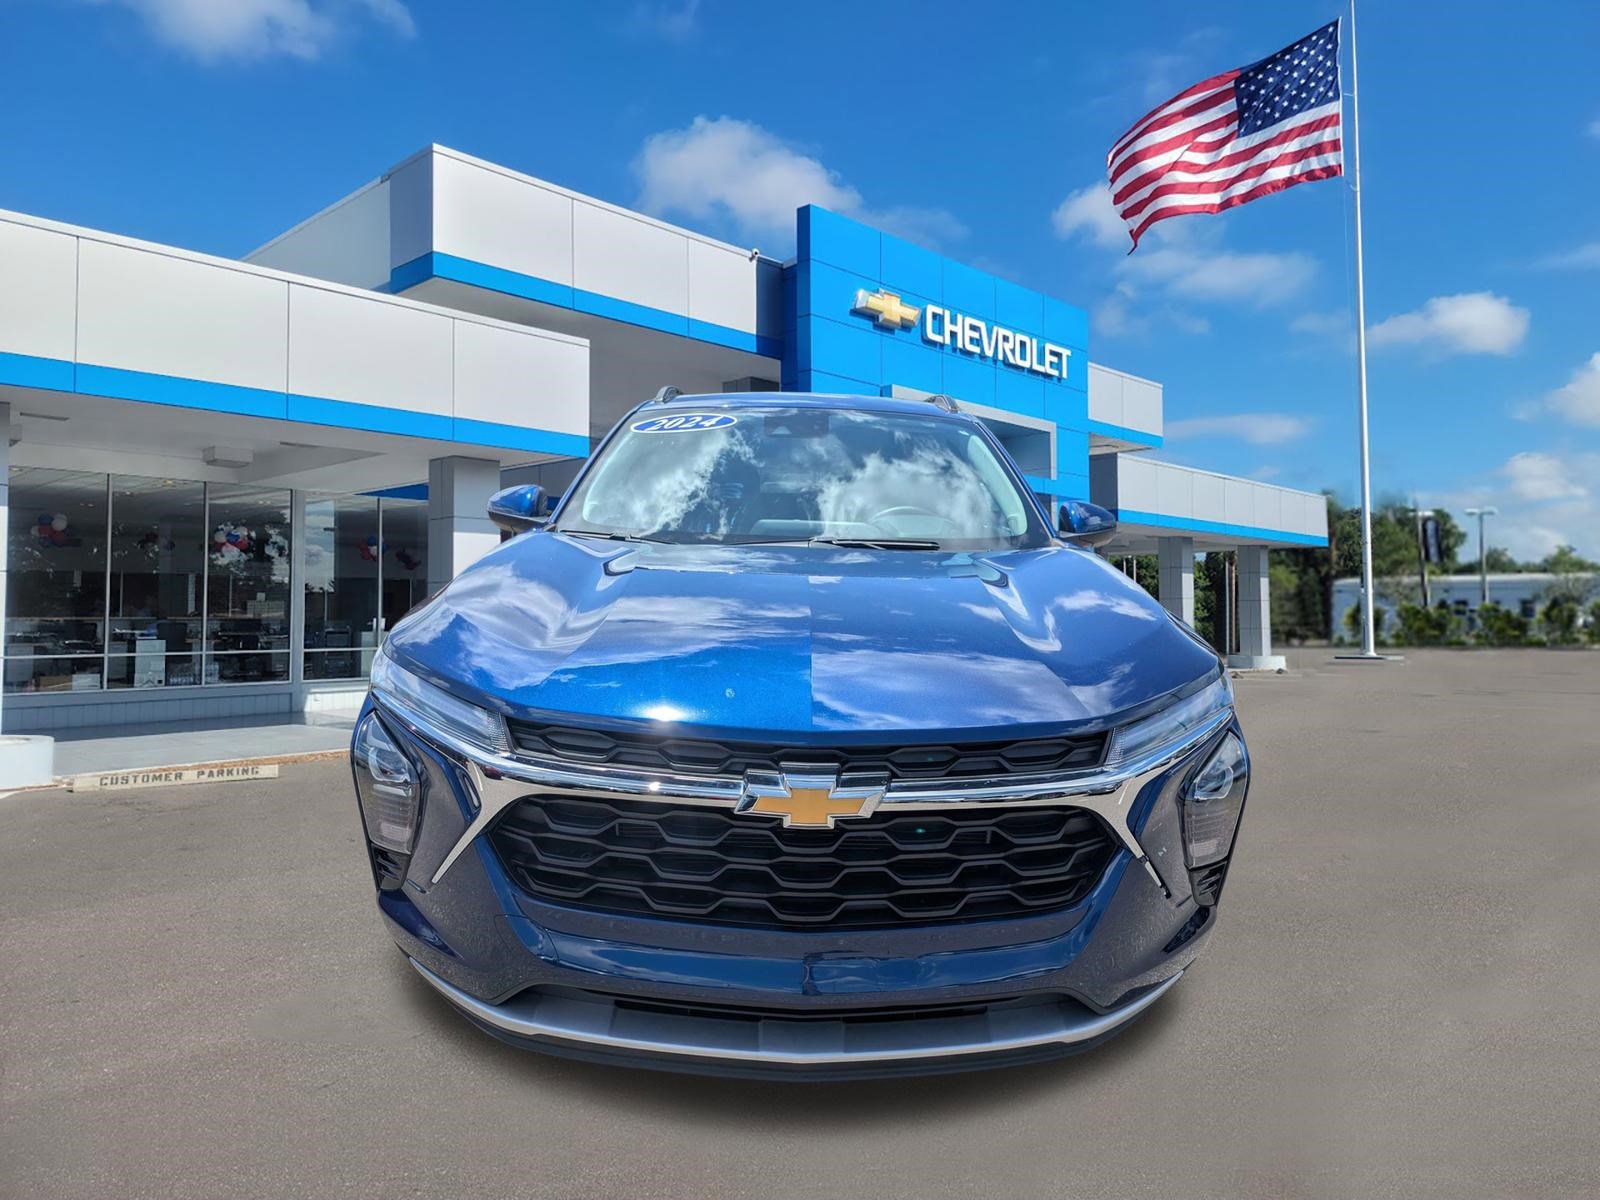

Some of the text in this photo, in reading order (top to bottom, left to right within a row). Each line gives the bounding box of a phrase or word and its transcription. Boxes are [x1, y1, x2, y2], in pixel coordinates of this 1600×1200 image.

[924, 303, 1072, 379] CHEVROLET
[646, 415, 720, 431] 2024
[100, 766, 260, 786] CUSTOMER PARKING
